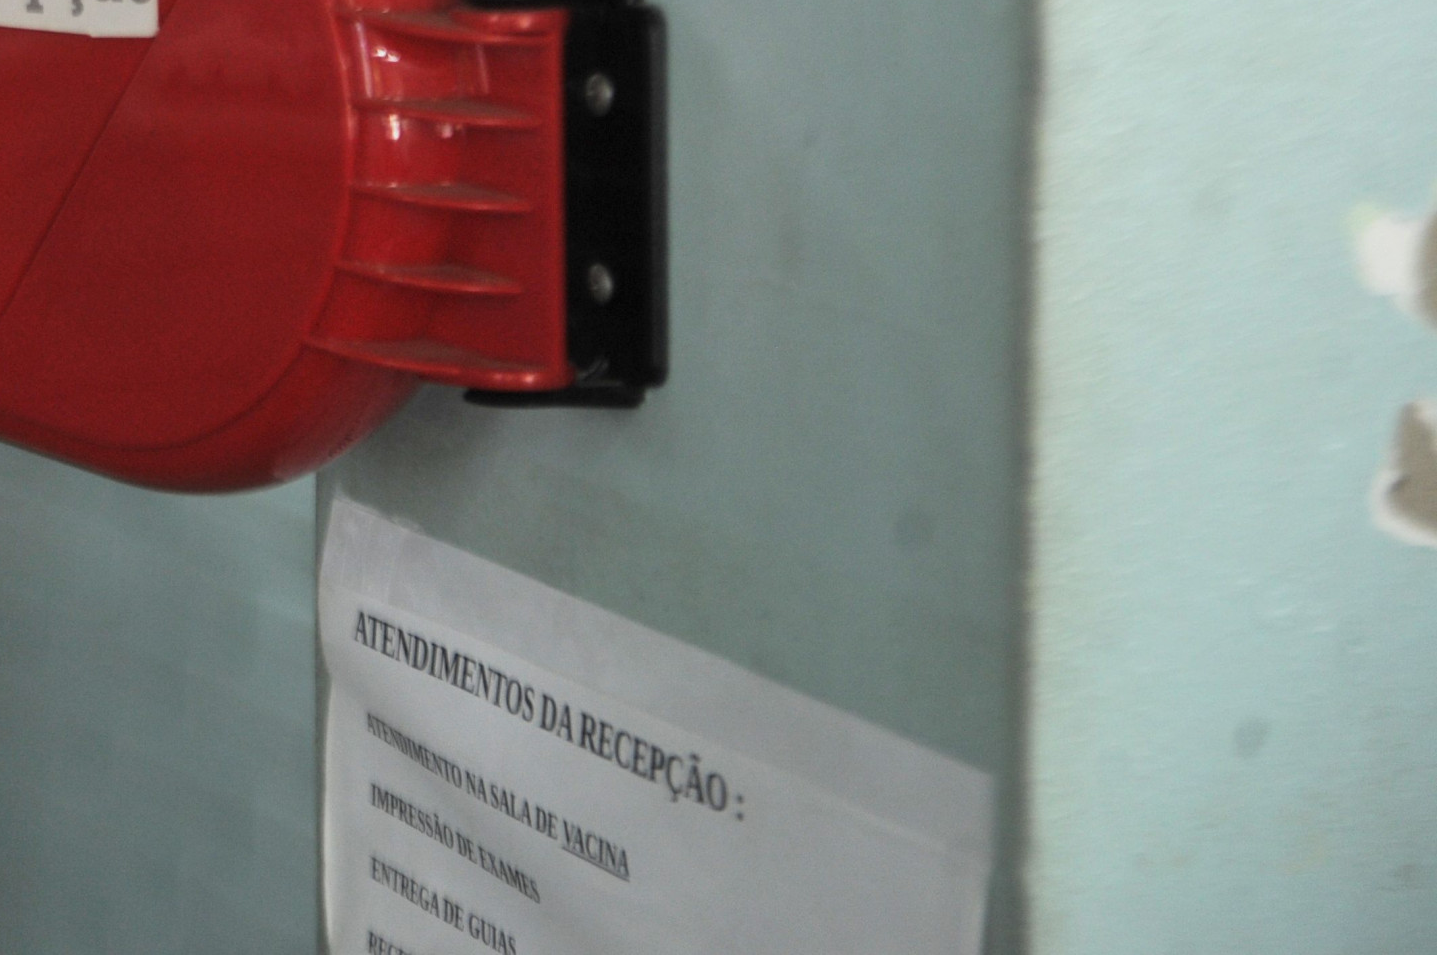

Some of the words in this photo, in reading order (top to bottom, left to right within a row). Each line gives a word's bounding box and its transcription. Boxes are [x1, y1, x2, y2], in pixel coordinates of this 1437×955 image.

[354, 611, 535, 723] ATENDIMENTOS
[540, 693, 574, 743] DA
[579, 711, 728, 812] RECEPÇÃO
[367, 712, 463, 789] ATENDIMENTO
[465, 769, 488, 805] NA
[490, 783, 532, 828] SALA
[535, 805, 558, 840] DE
[563, 818, 630, 878] VACINA
[370, 783, 454, 850] IMPRESSÃO
[456, 831, 477, 865] DE
[478, 845, 541, 904] EXAMES
[370, 856, 440, 919] ENTREGA
[442, 897, 465, 932] DE
[468, 913, 517, 955] GUIAS
